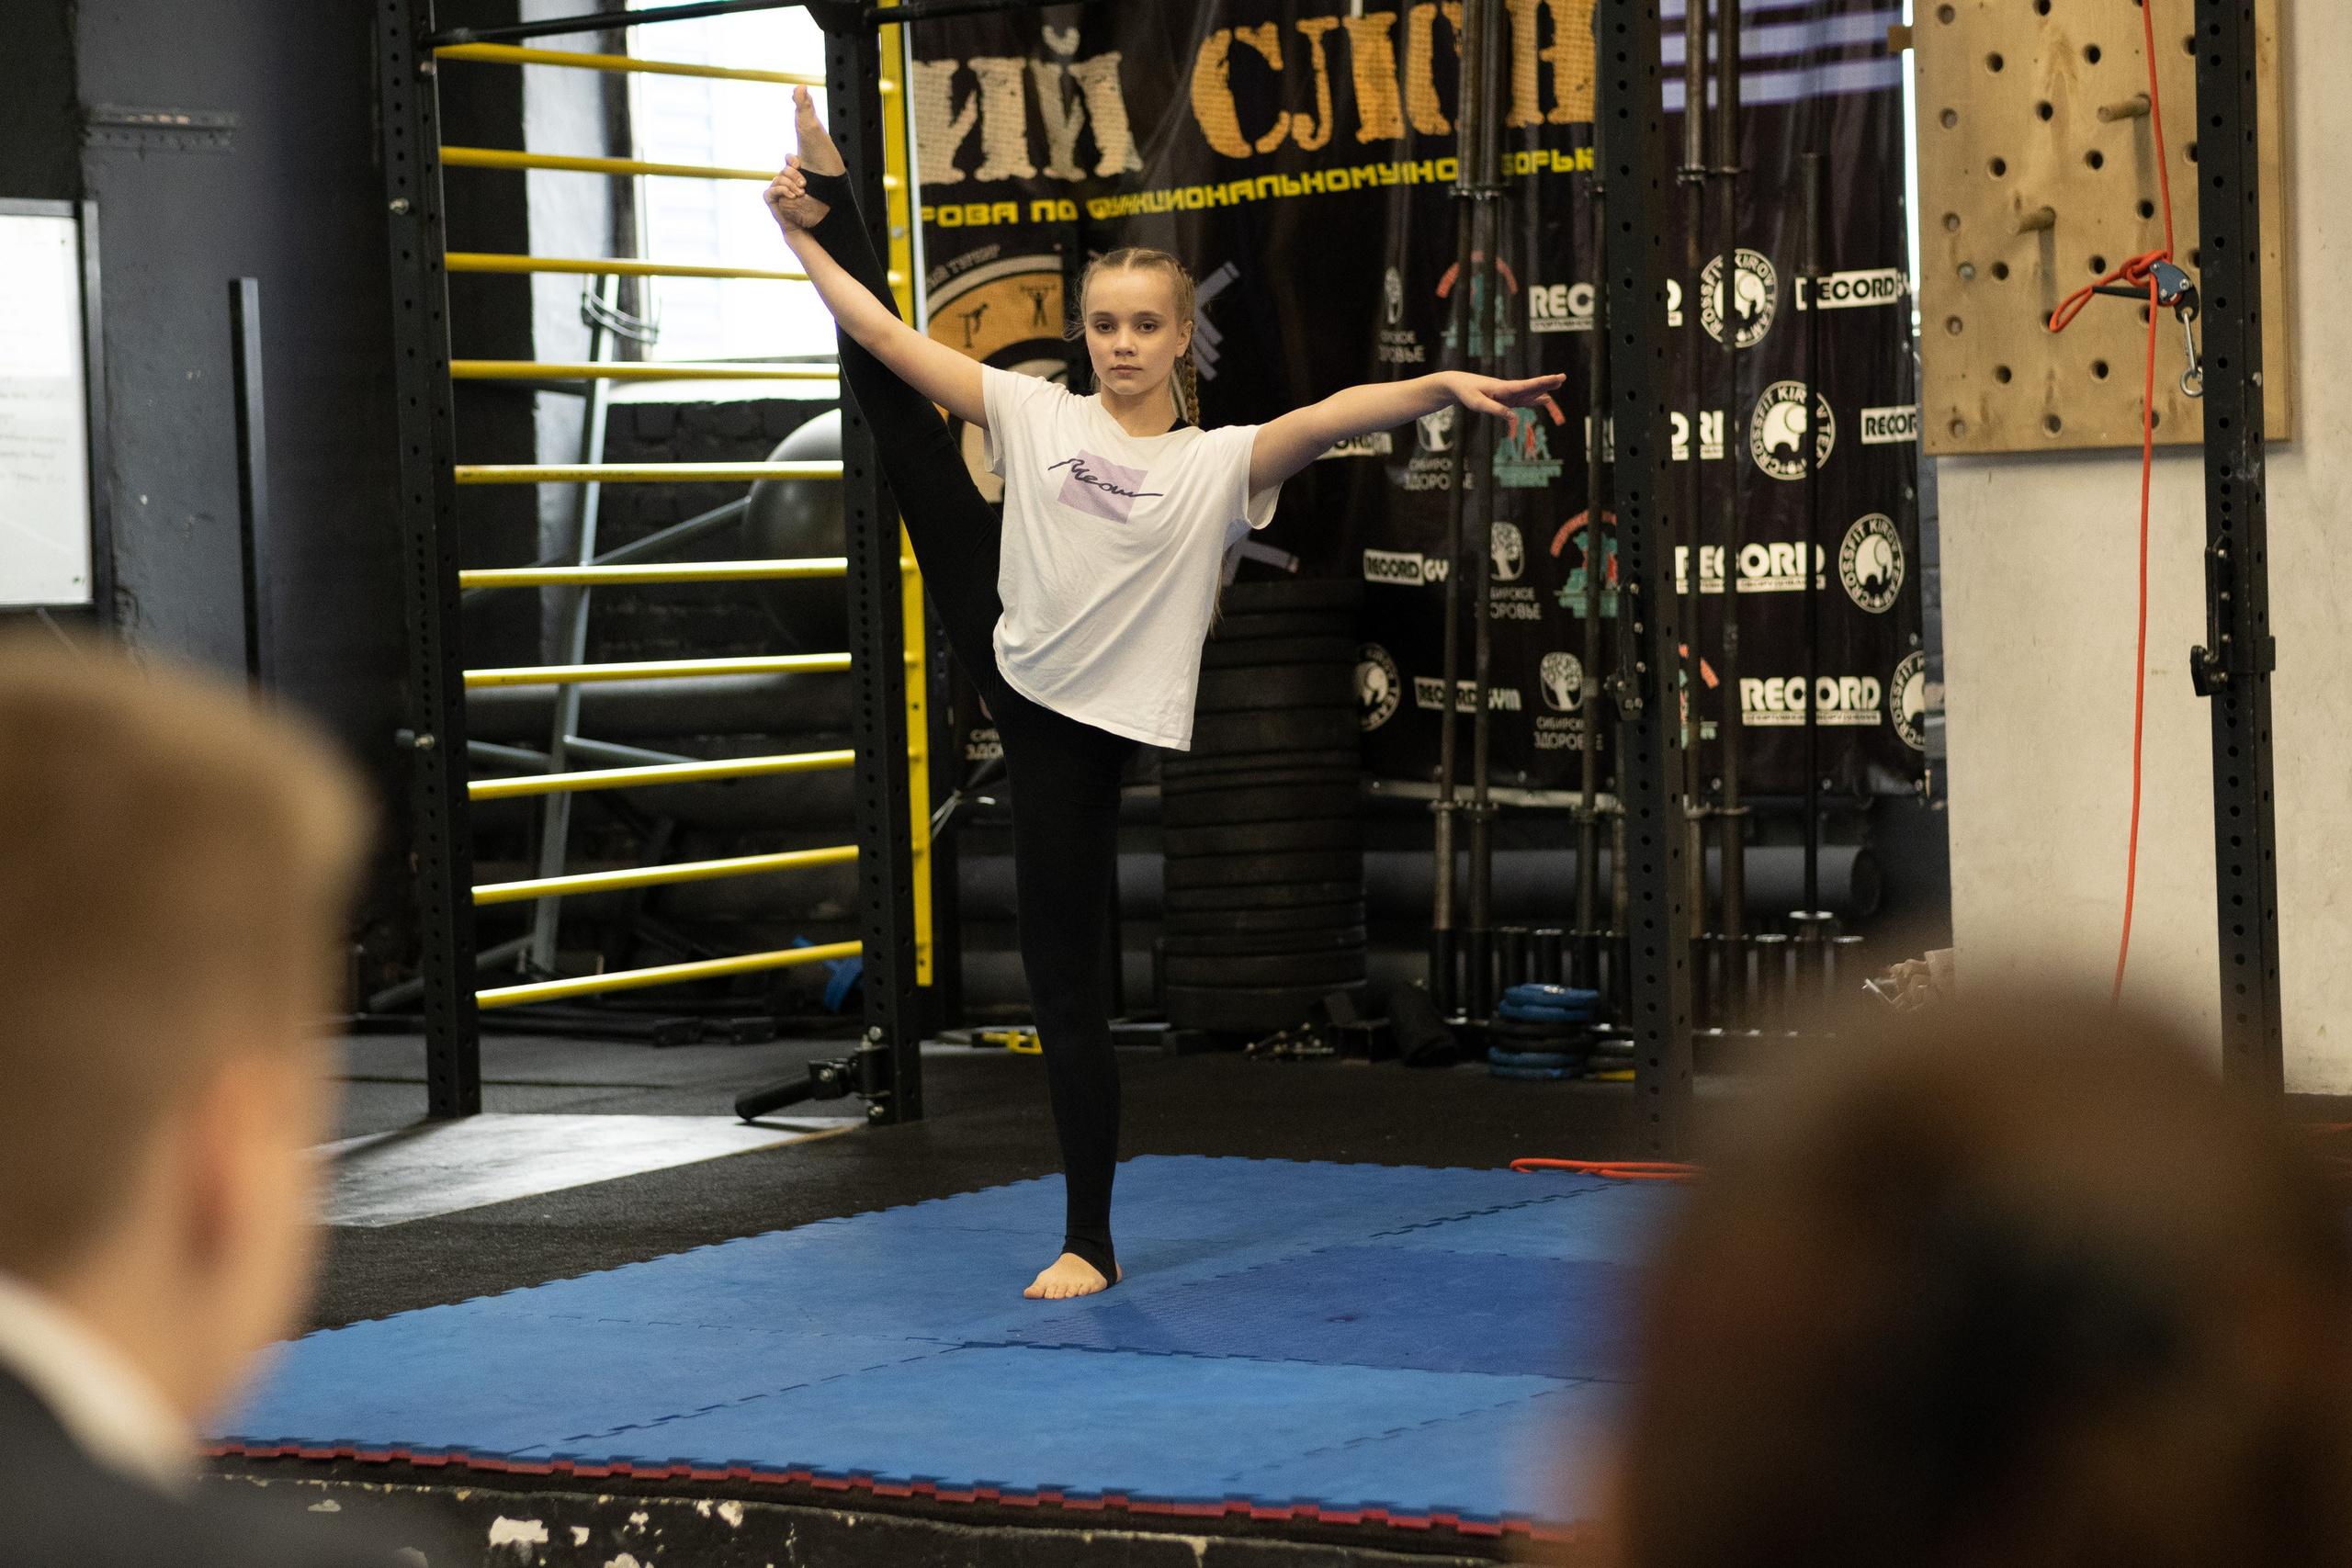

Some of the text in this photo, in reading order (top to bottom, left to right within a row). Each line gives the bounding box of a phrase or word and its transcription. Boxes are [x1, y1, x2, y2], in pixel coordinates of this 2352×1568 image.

[1819, 276, 1894, 300] ECORD
[1778, 386, 1826, 419] KIRV
[1047, 458, 1163, 498] Meow
[1843, 525, 1871, 606] CROSSFIT
[1740, 676, 1881, 710] RECORD
